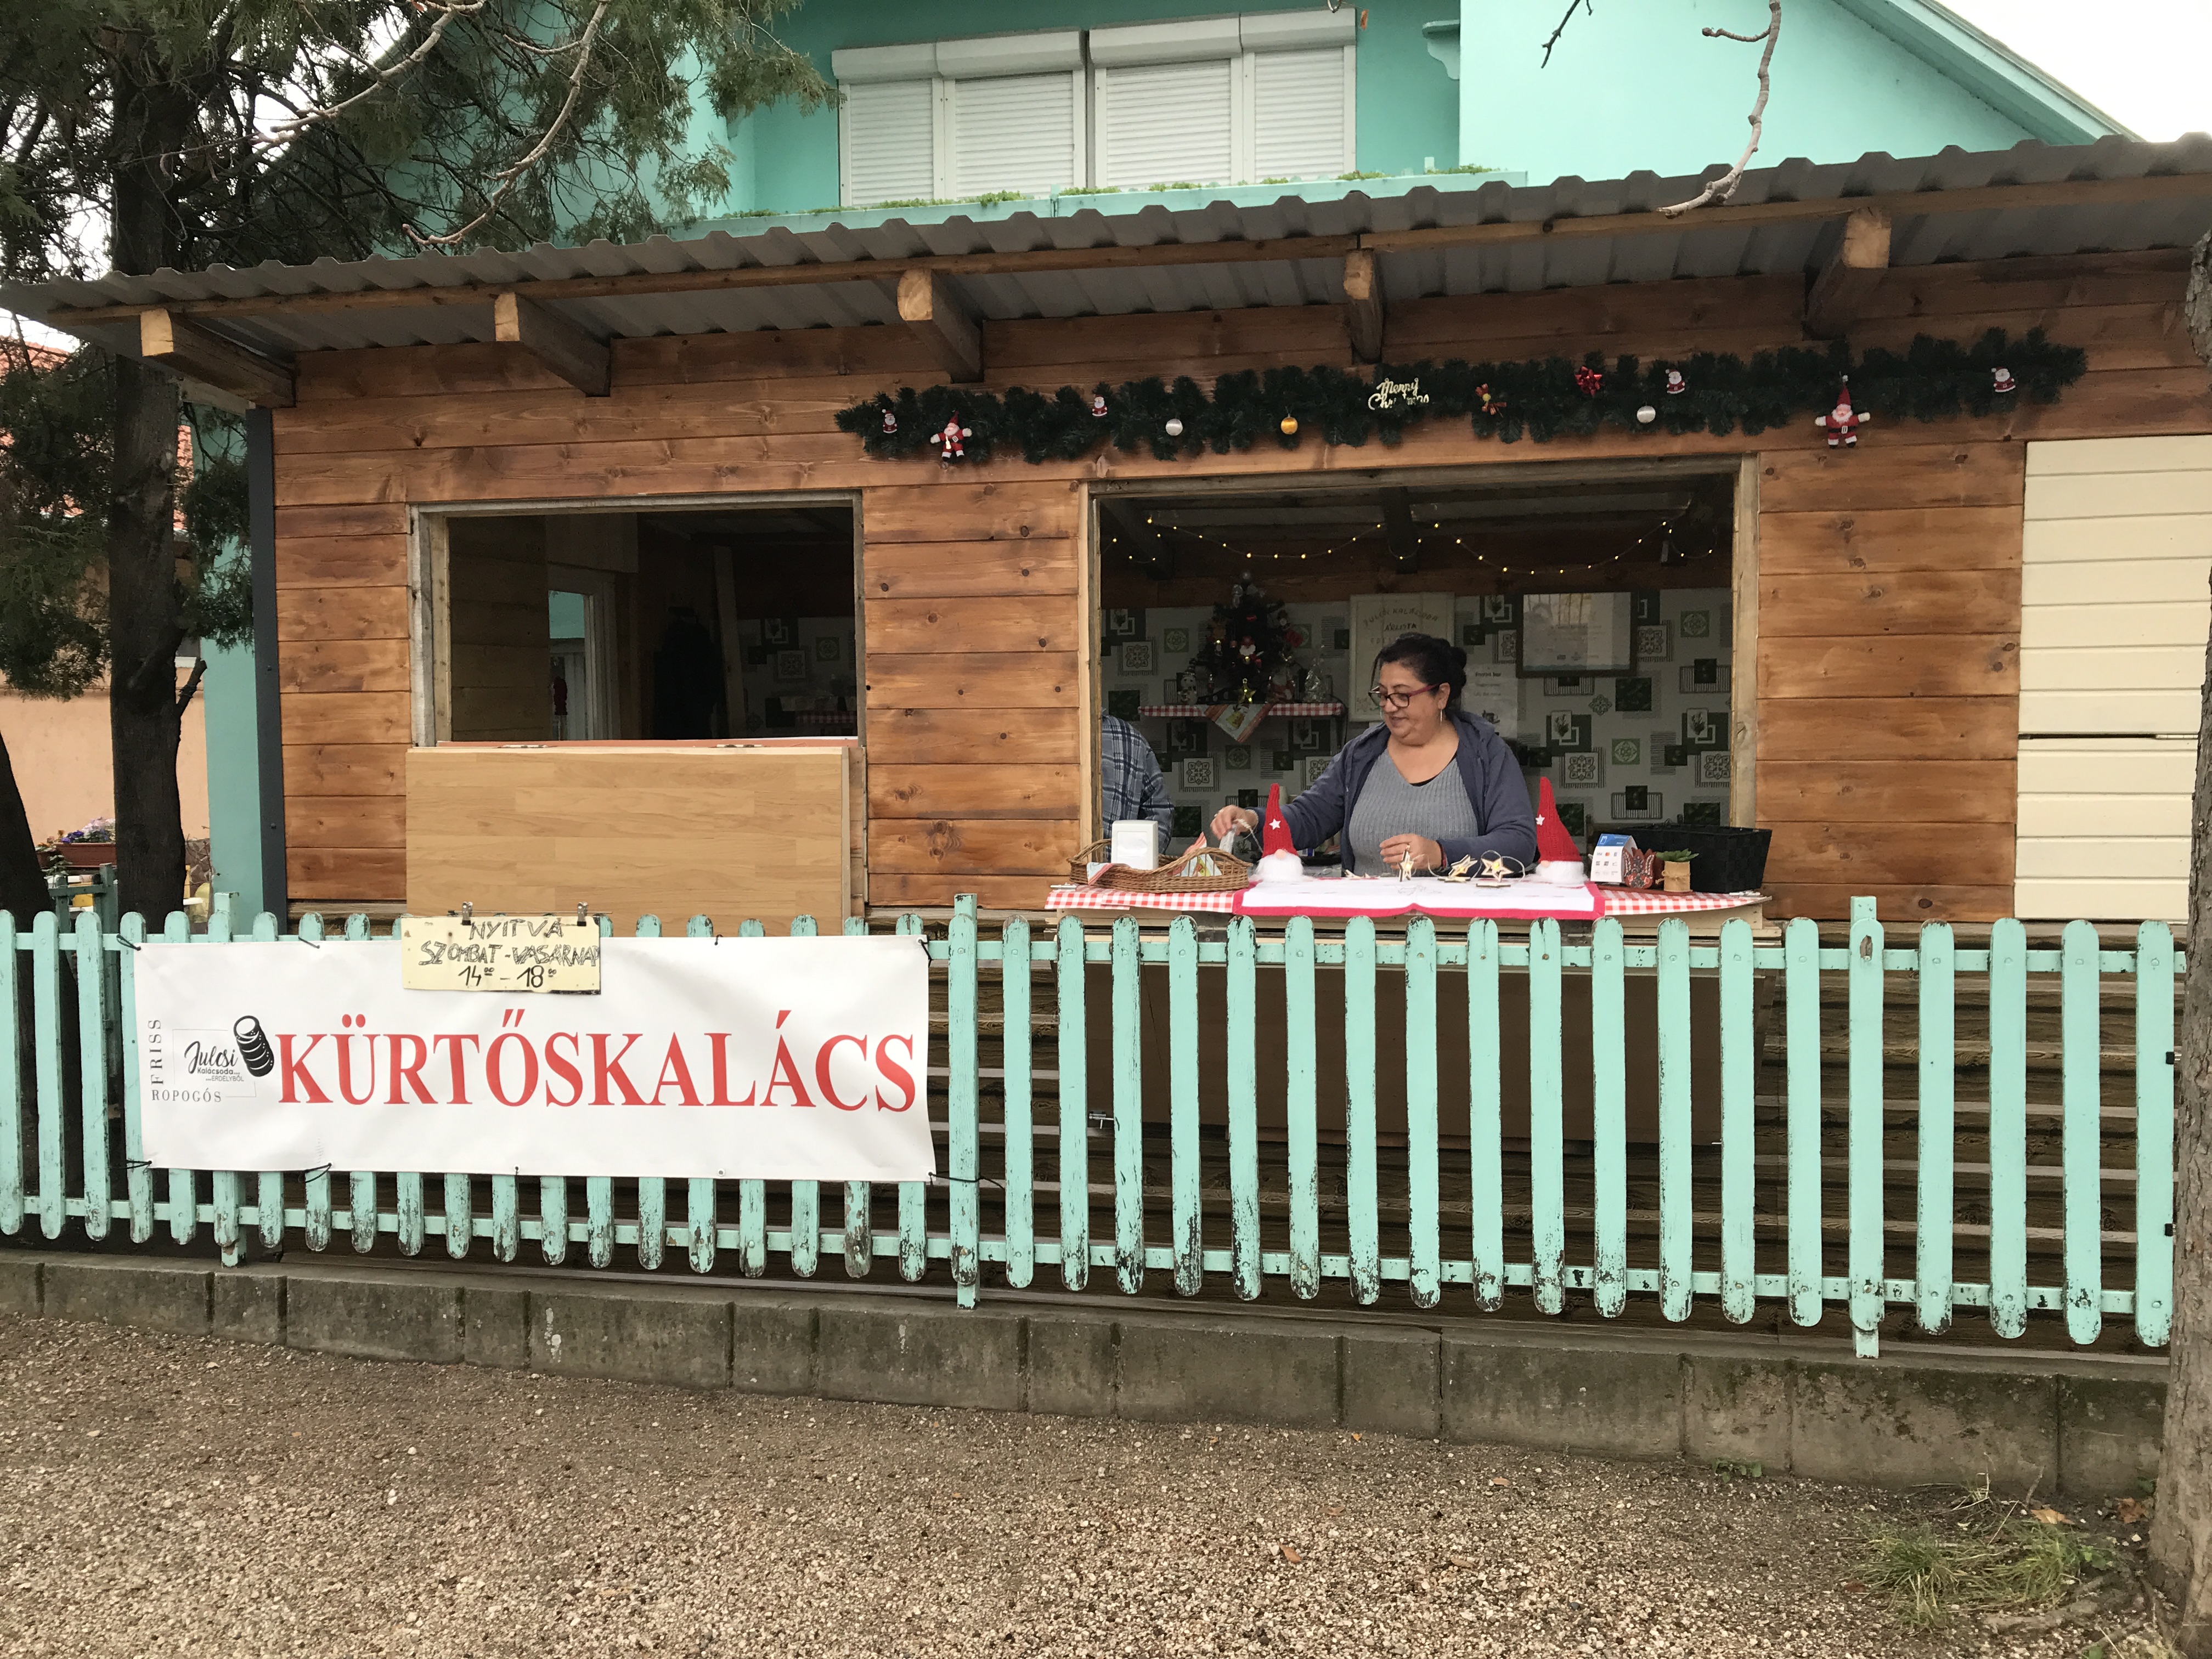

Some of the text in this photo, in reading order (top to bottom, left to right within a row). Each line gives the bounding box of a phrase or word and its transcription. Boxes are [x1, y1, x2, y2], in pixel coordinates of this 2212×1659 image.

[1376, 379, 1419, 397] Merry
[469, 918, 563, 940] NYITVA
[148, 1019, 164, 1086] FRISS
[184, 1040, 238, 1074] Julcsi
[275, 1008, 916, 1112] KÜRTŐSKALÁCS
[151, 1087, 222, 1103] ROPOGÓS
